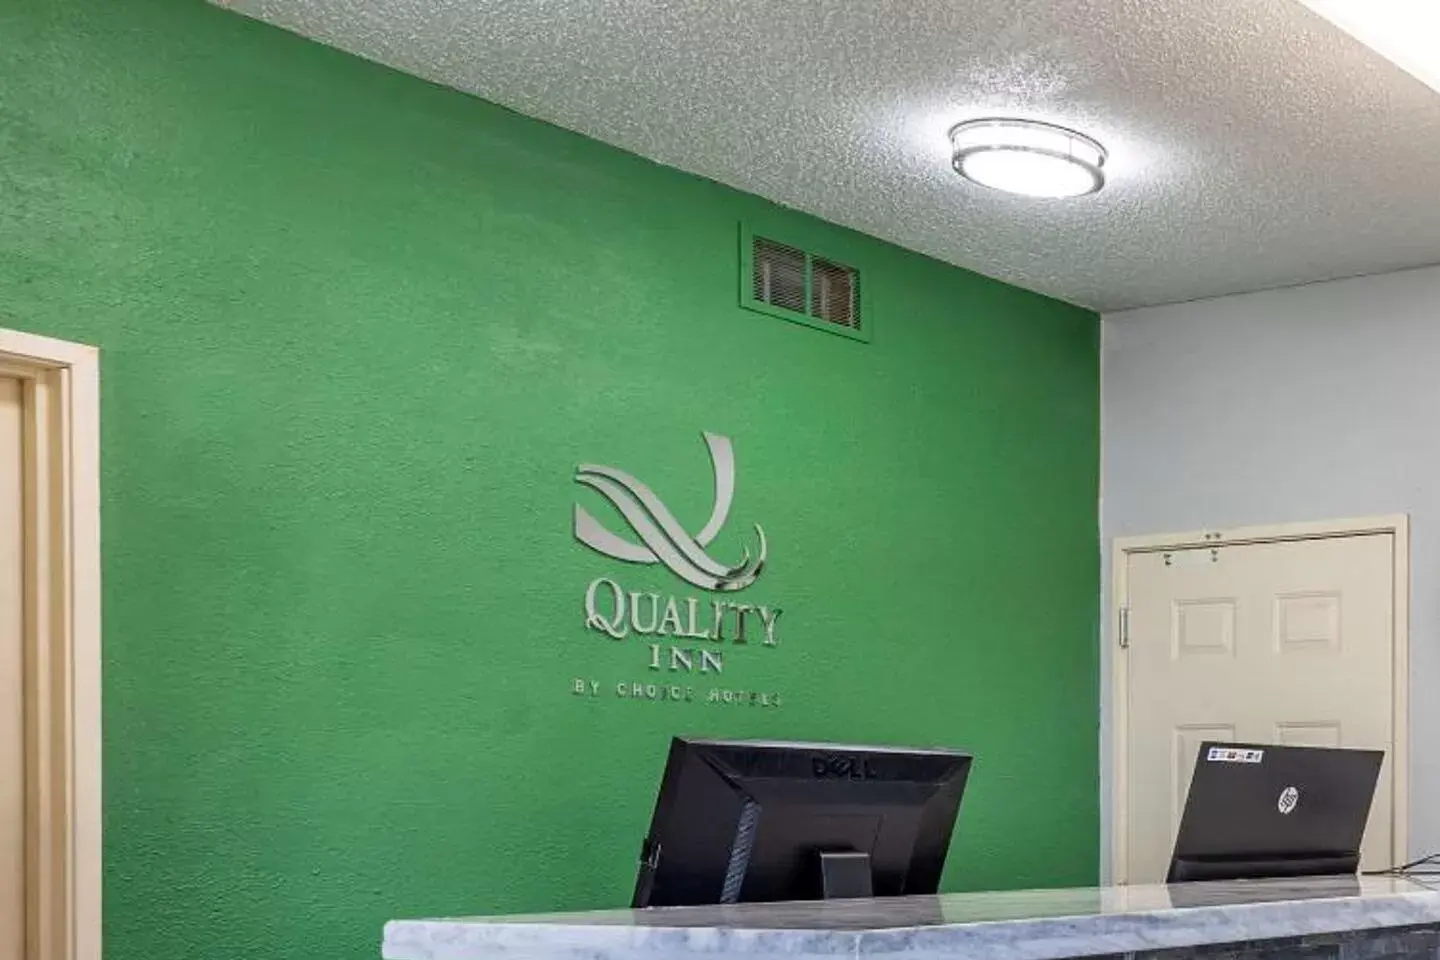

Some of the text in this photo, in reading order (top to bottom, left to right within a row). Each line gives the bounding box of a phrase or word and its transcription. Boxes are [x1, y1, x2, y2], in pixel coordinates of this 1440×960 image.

[584, 577, 783, 647] QUALITY
[648, 643, 724, 674] INN
[574, 679, 600, 695] BY
[615, 681, 694, 703] CHOICE
[811, 756, 879, 781] DELL
